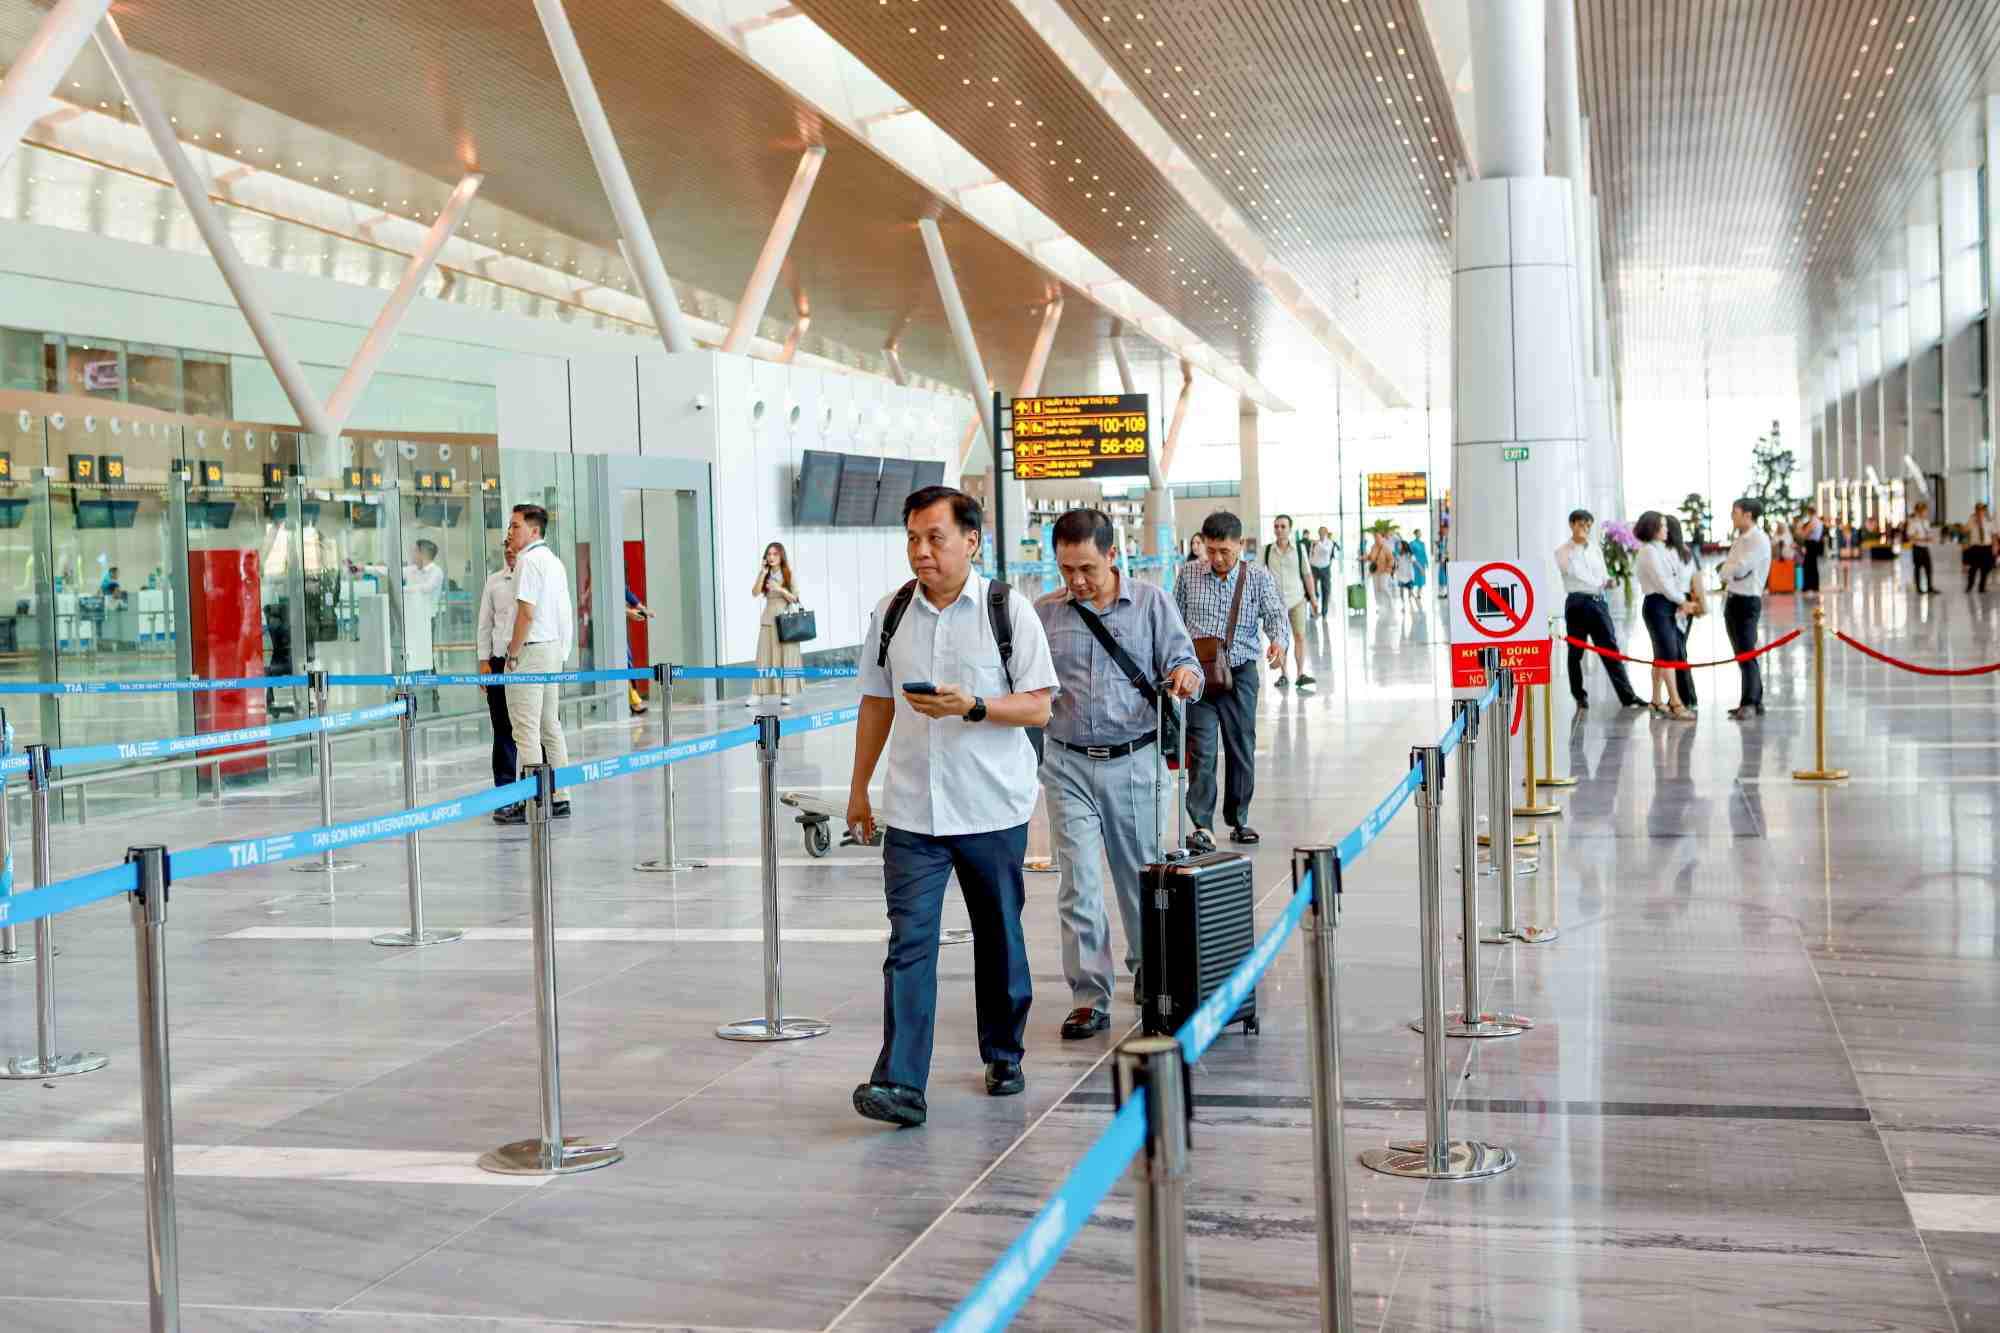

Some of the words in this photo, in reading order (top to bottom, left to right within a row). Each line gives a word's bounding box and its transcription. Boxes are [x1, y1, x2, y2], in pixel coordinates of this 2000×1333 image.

[1099, 416, 1146, 433] 100-109
[1100, 437, 1145, 454] 56-99
[79, 460, 92, 477] 57
[550, 673, 578, 681] AIRPORT
[757, 668, 778, 678] TIA
[1469, 674, 1484, 685] NO
[211, 679, 238, 688] AIRPORT
[392, 676, 414, 686] TIA
[64, 684, 83, 694] TIA
[118, 745, 137, 759] TIA
[582, 763, 600, 781] TIA
[312, 832, 330, 847] TAN
[331, 827, 349, 843] SON
[350, 823, 371, 839] NHAT
[373, 811, 430, 833] INTERNATIONAL
[431, 801, 463, 822] AIRPORT
[229, 842, 259, 867] TIA
